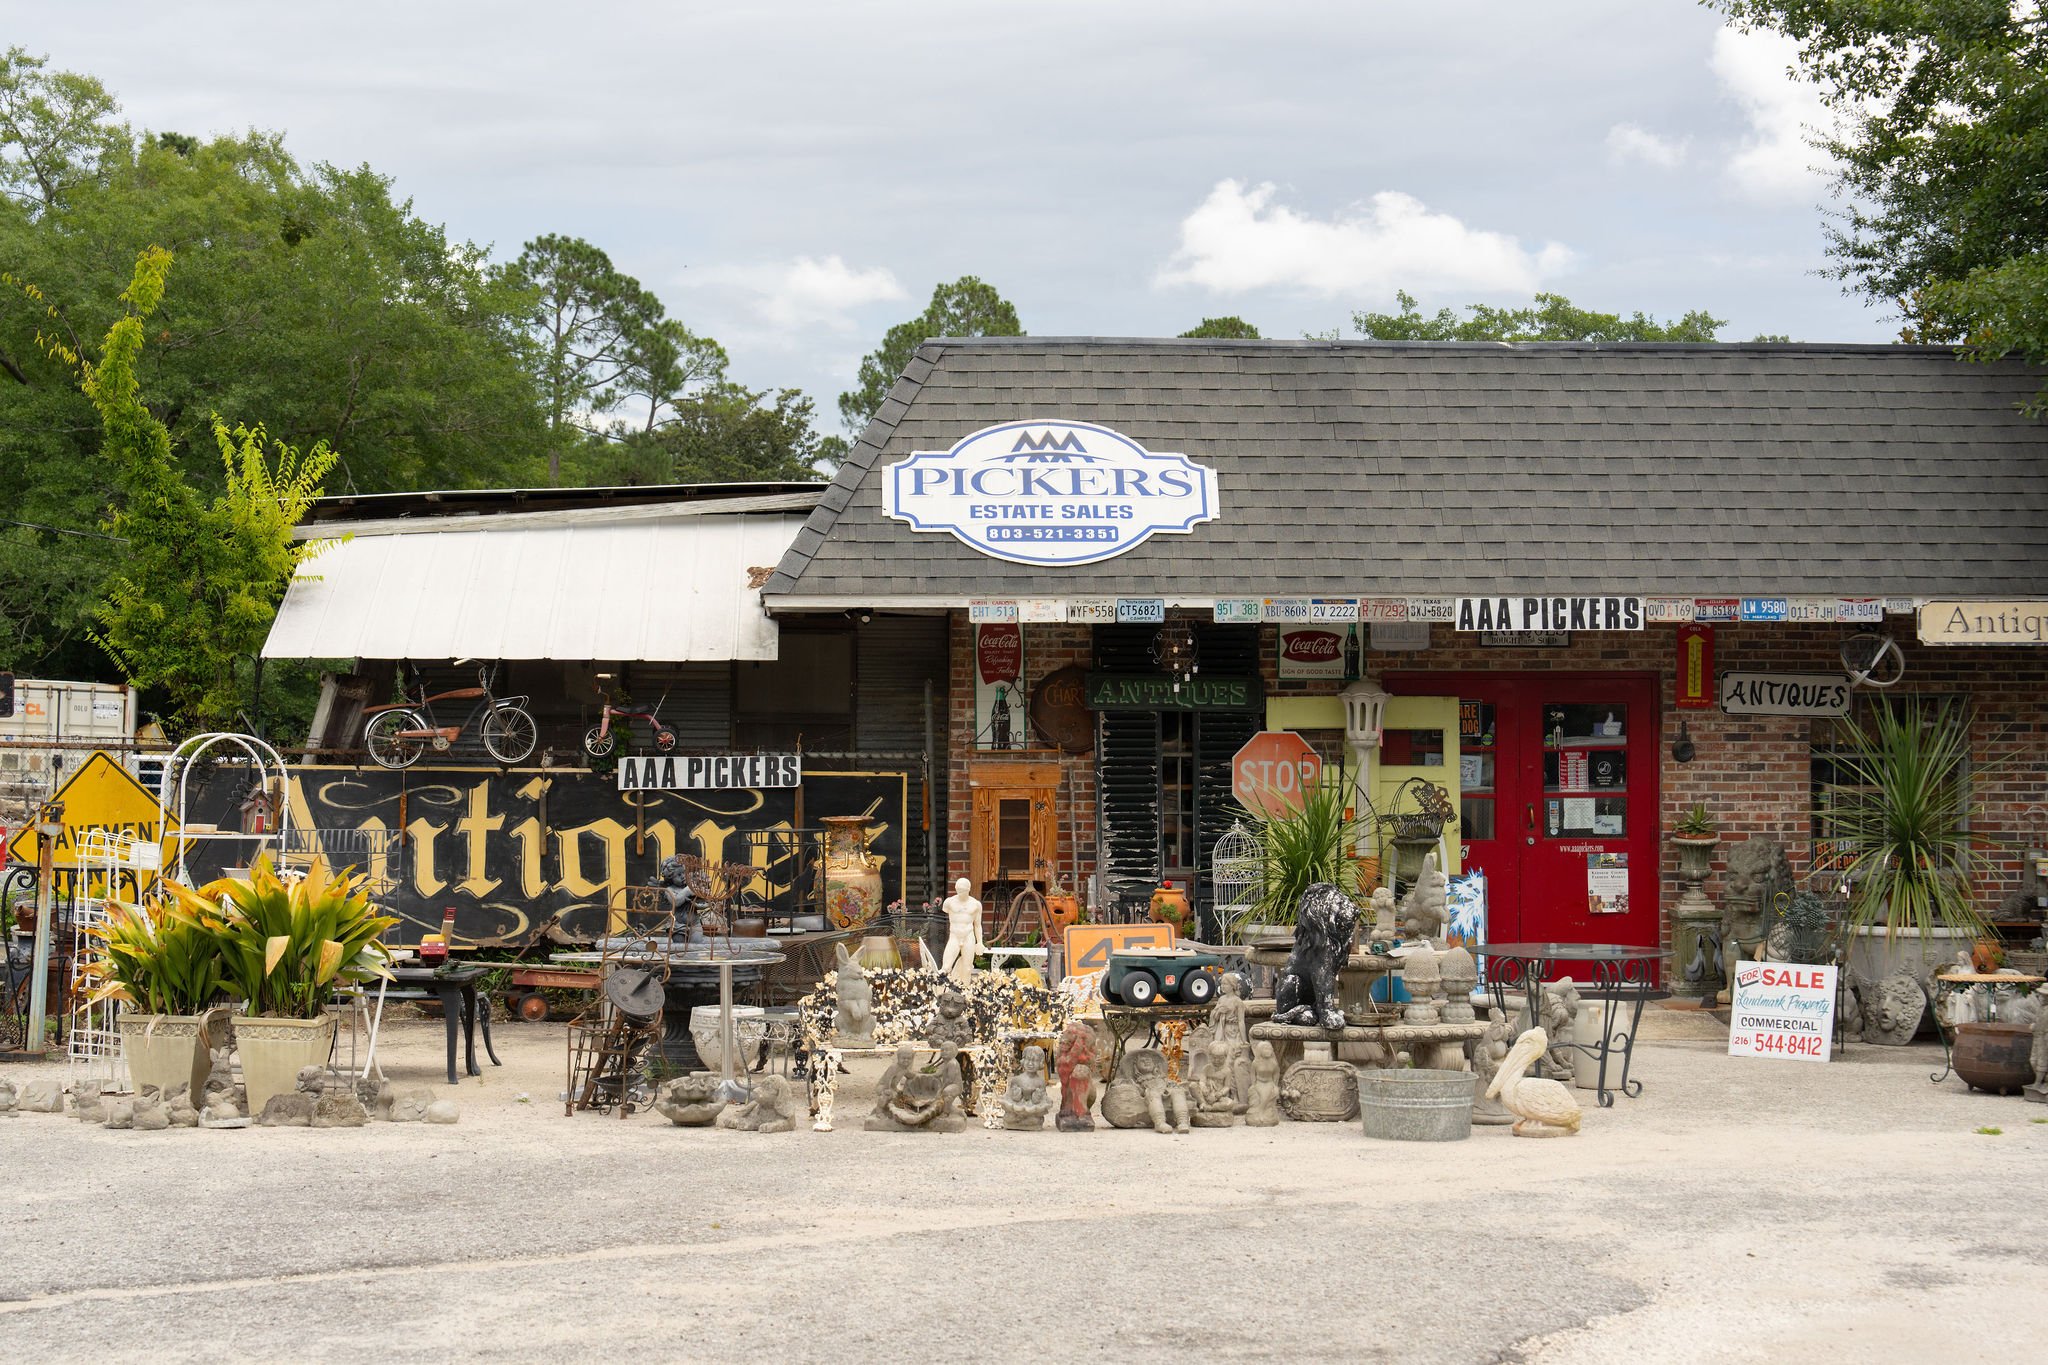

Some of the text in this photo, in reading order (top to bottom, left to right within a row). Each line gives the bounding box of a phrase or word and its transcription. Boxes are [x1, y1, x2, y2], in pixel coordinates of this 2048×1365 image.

[908, 467, 1194, 498] PICKERS
[969, 504, 1134, 520] ESTATE SALES
[988, 529, 1117, 540] 803-521-3351
[996, 606, 1016, 617] 513
[1070, 605, 1088, 618] WYF
[1095, 605, 1114, 618] 558
[1119, 605, 1160, 617] CT56821
[1217, 603, 1259, 615] 951 383
[1265, 605, 1307, 617] XBU-8608
[1313, 606, 1355, 617] 2V 2222
[1458, 597, 1639, 630] AAA PICKERS
[1675, 604, 1691, 616] 169
[1761, 601, 1786, 613] 9580
[1839, 604, 1879, 616] GHA 9044
[1944, 605, 2048, 640] Antiq
[980, 634, 1019, 649] Coca-Cola
[1289, 637, 1337, 655] Coca-Cola
[1093, 679, 1248, 707] ANTIQUES
[1726, 679, 1847, 709] ANTIQUES
[1462, 719, 1479, 734] DOG
[623, 755, 798, 788] AAA PICKERS
[1238, 760, 1315, 793] STOP
[250, 770, 890, 938] Antique
[1741, 969, 1824, 989] FOR SALE
[1736, 990, 1830, 1017] Landmark Property
[1741, 1017, 1818, 1031] COMMERCIAL
[1732, 1035, 1751, 1046] (216)
